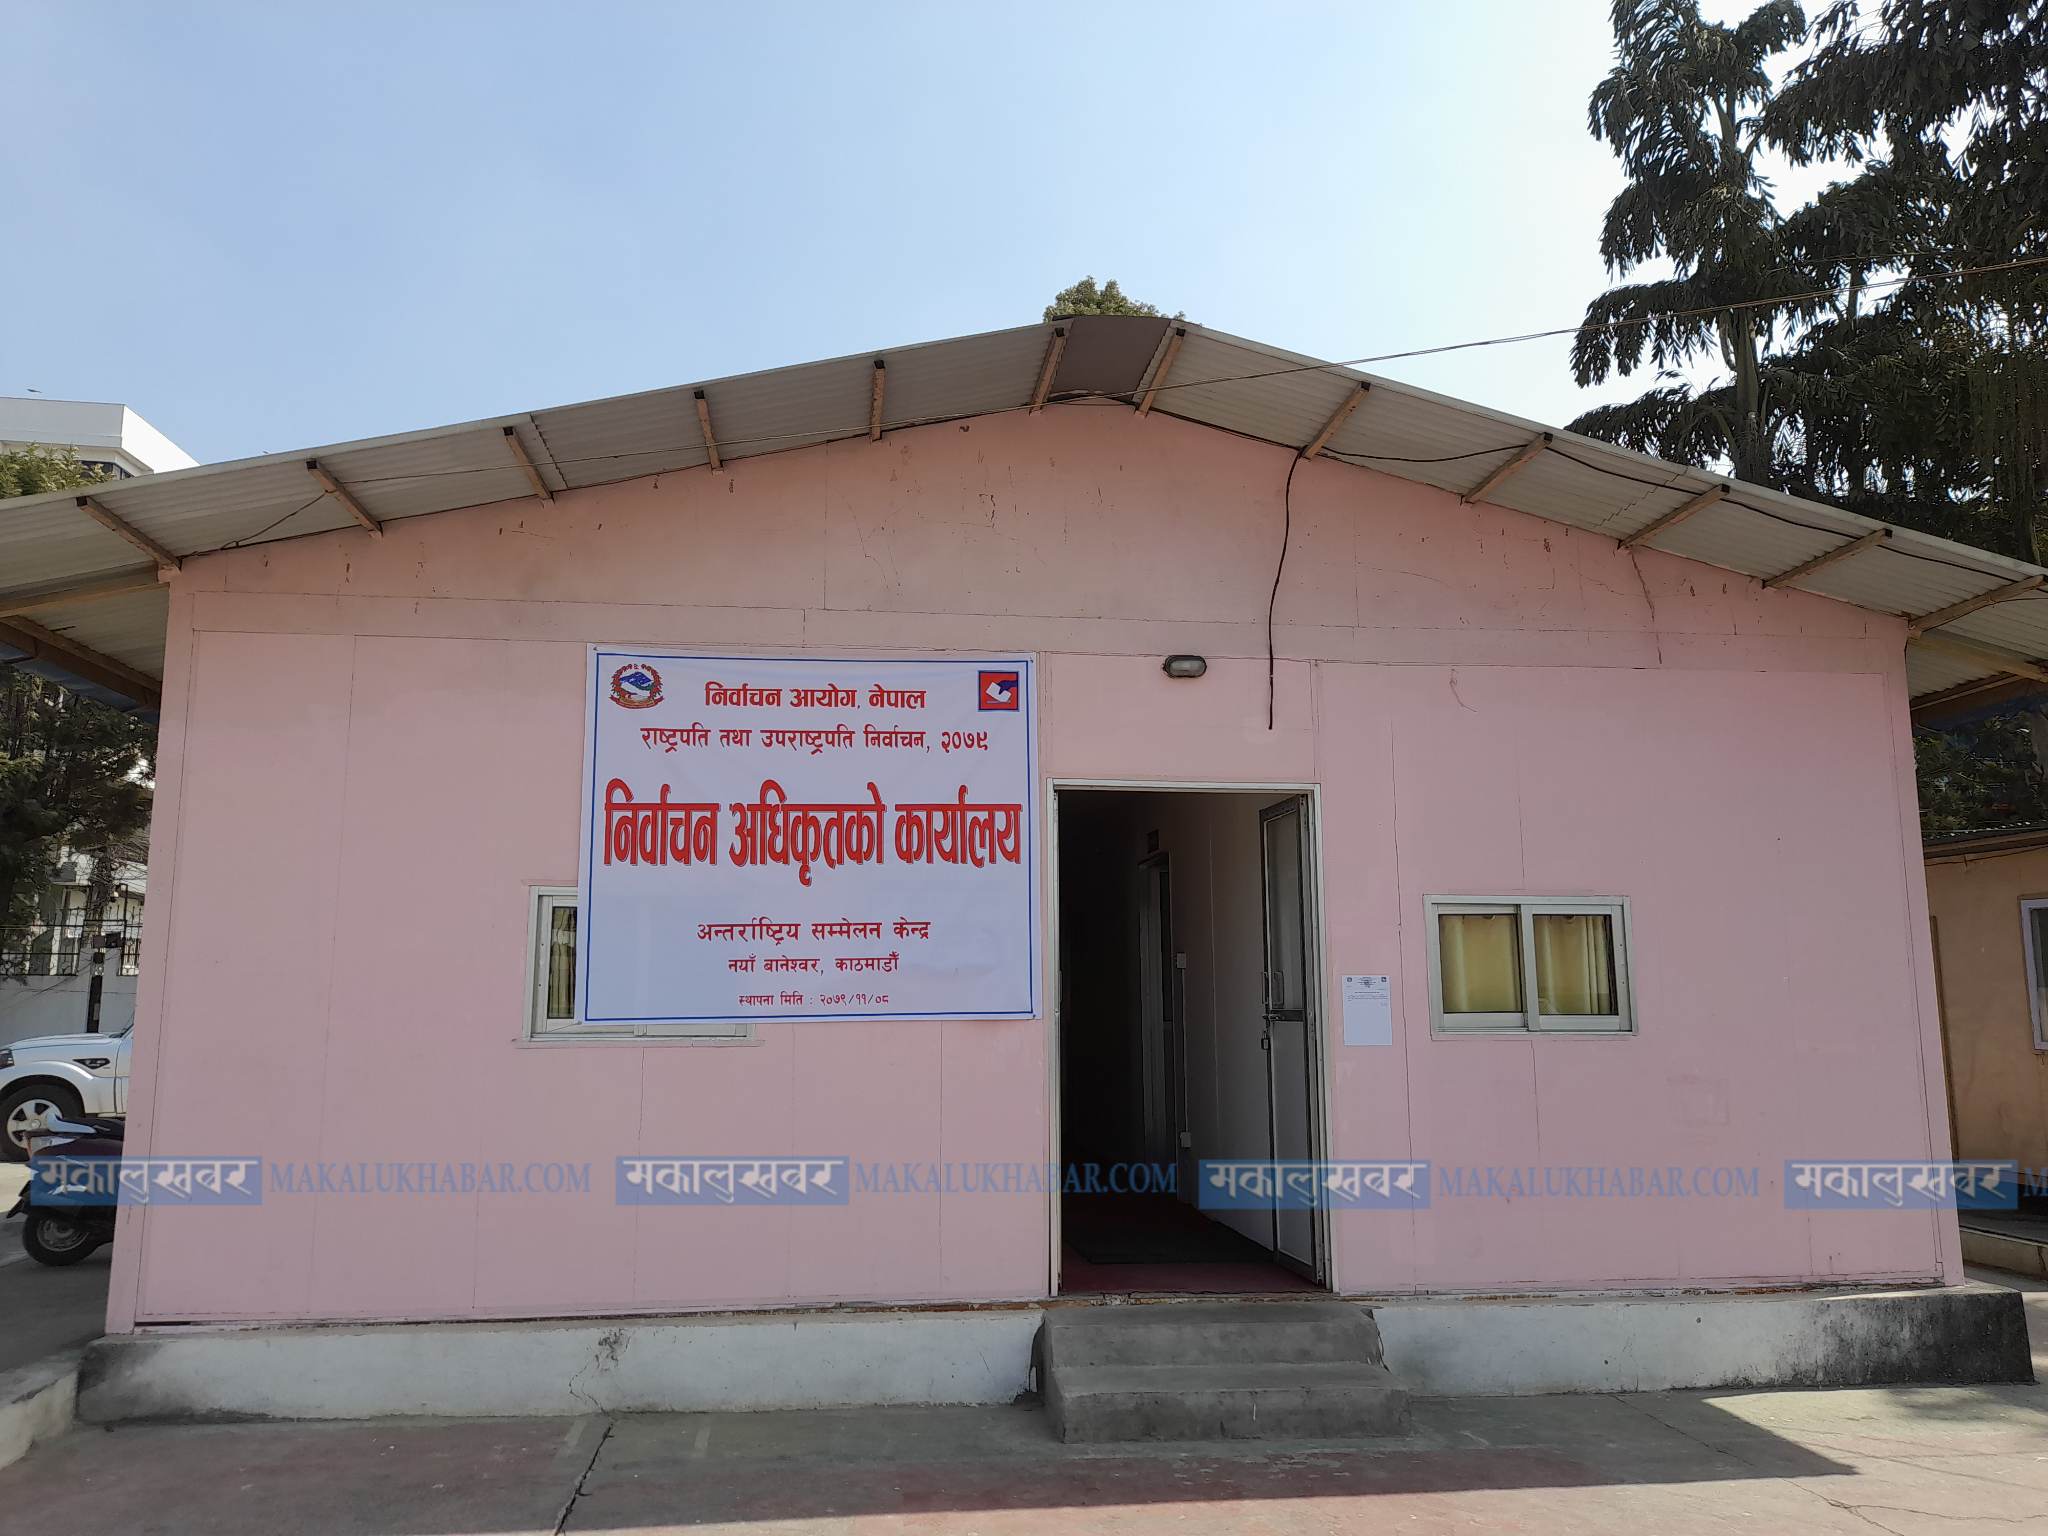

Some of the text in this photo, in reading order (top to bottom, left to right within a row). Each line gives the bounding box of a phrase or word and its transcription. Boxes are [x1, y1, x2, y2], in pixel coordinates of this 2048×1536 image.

[705, 681, 927, 710] निर्वाचन आयोग, नेपाल
[640, 722, 989, 755] राष्ट्रपति तथा उपराष्ट्रपति निर्वाचन, २०७९
[603, 778, 1023, 887] निर्वाचन अधिकृतको कार्यालय
[811, 917, 883, 941] सम्मेलन
[893, 916, 931, 940] केन्द्र
[728, 953, 756, 973] नयाँ
[764, 954, 824, 976] बानेश्वर,
[738, 995, 774, 1007] स्थापना
[780, 991, 804, 1006] मिति
[820, 992, 889, 1007] २०७९/११/०८
